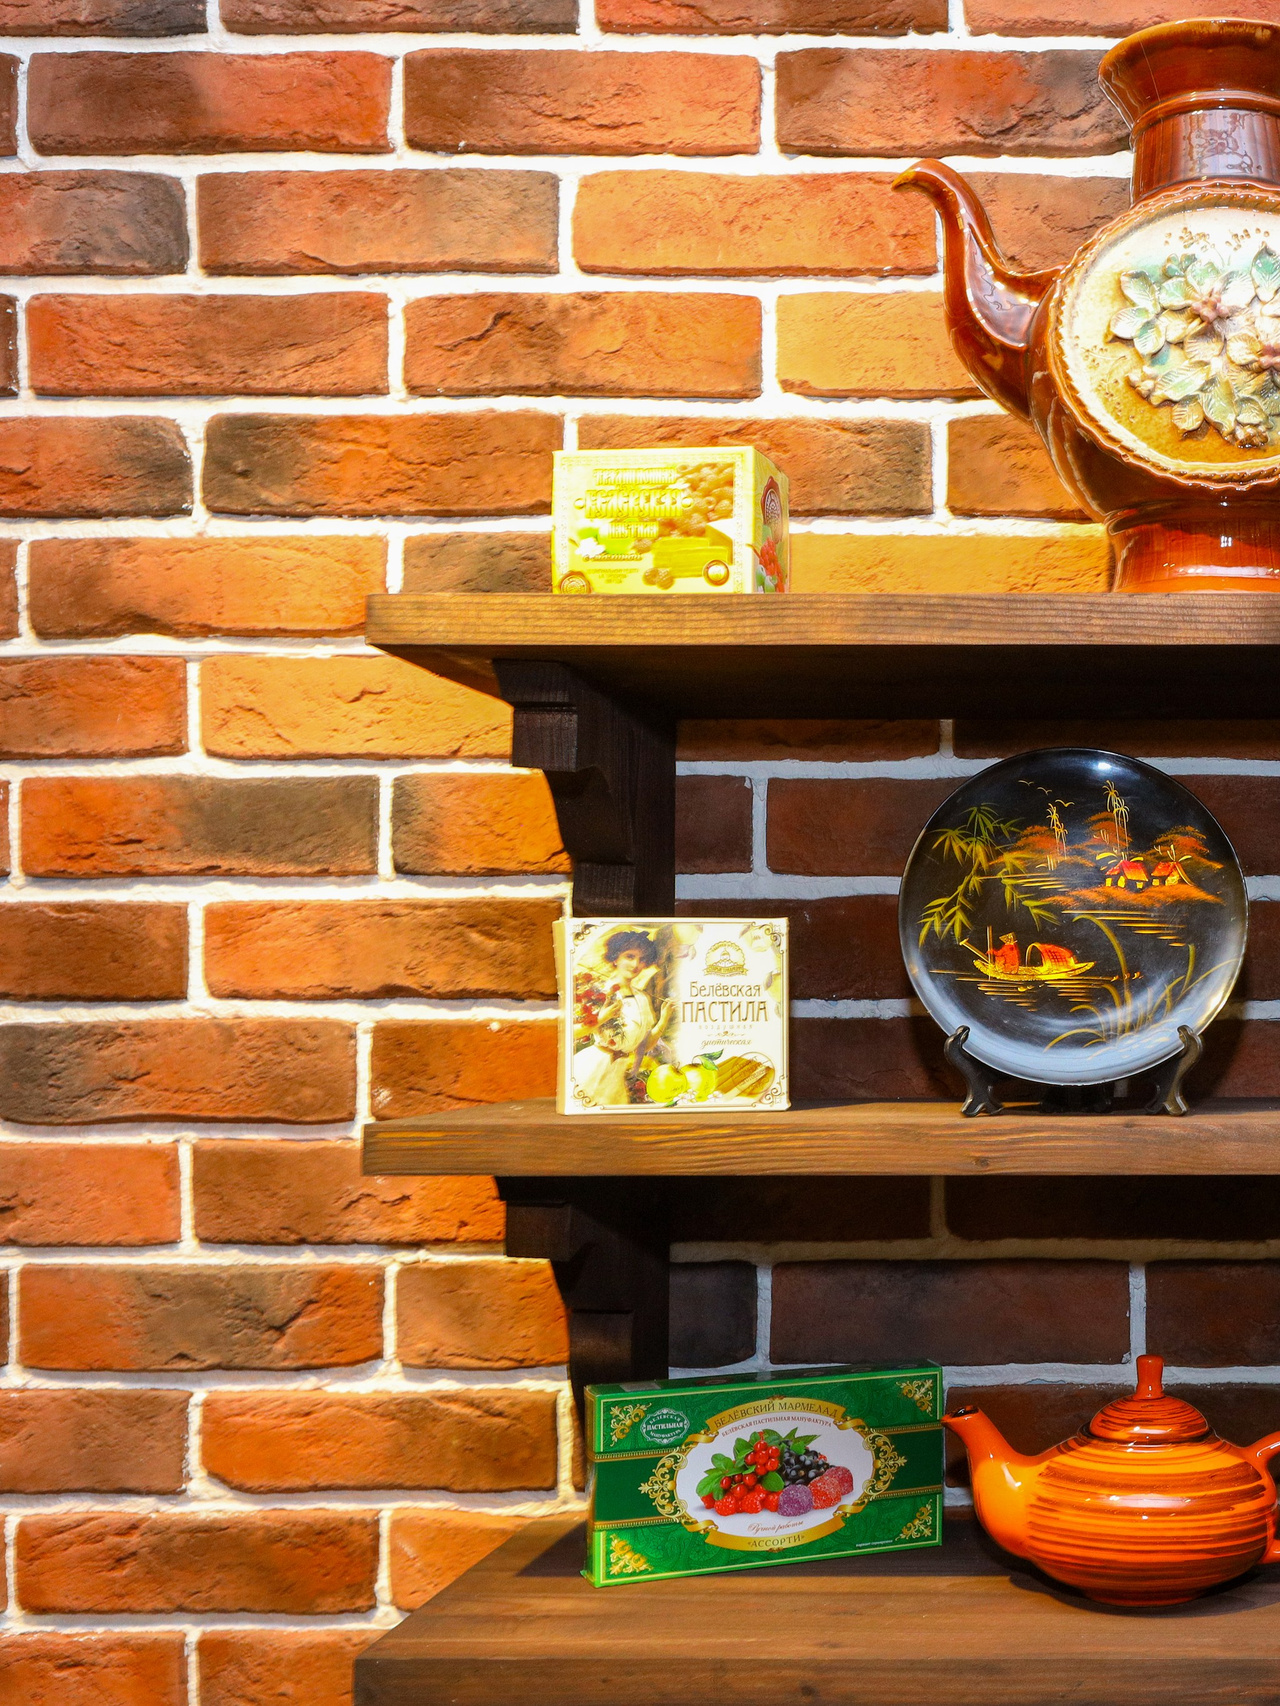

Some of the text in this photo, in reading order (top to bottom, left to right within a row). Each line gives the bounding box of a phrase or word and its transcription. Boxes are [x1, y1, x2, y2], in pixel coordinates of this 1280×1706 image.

[690, 981, 761, 997] Белёвская
[682, 1001, 768, 1022] ПАСТИЛА
[714, 1401, 838, 1428] БЕЛЁВСКИЙ МАРМЕЛАД
[791, 1415, 832, 1428] МАНУФАКТУРА
[747, 1534, 805, 1548] «АССОРТИ»
